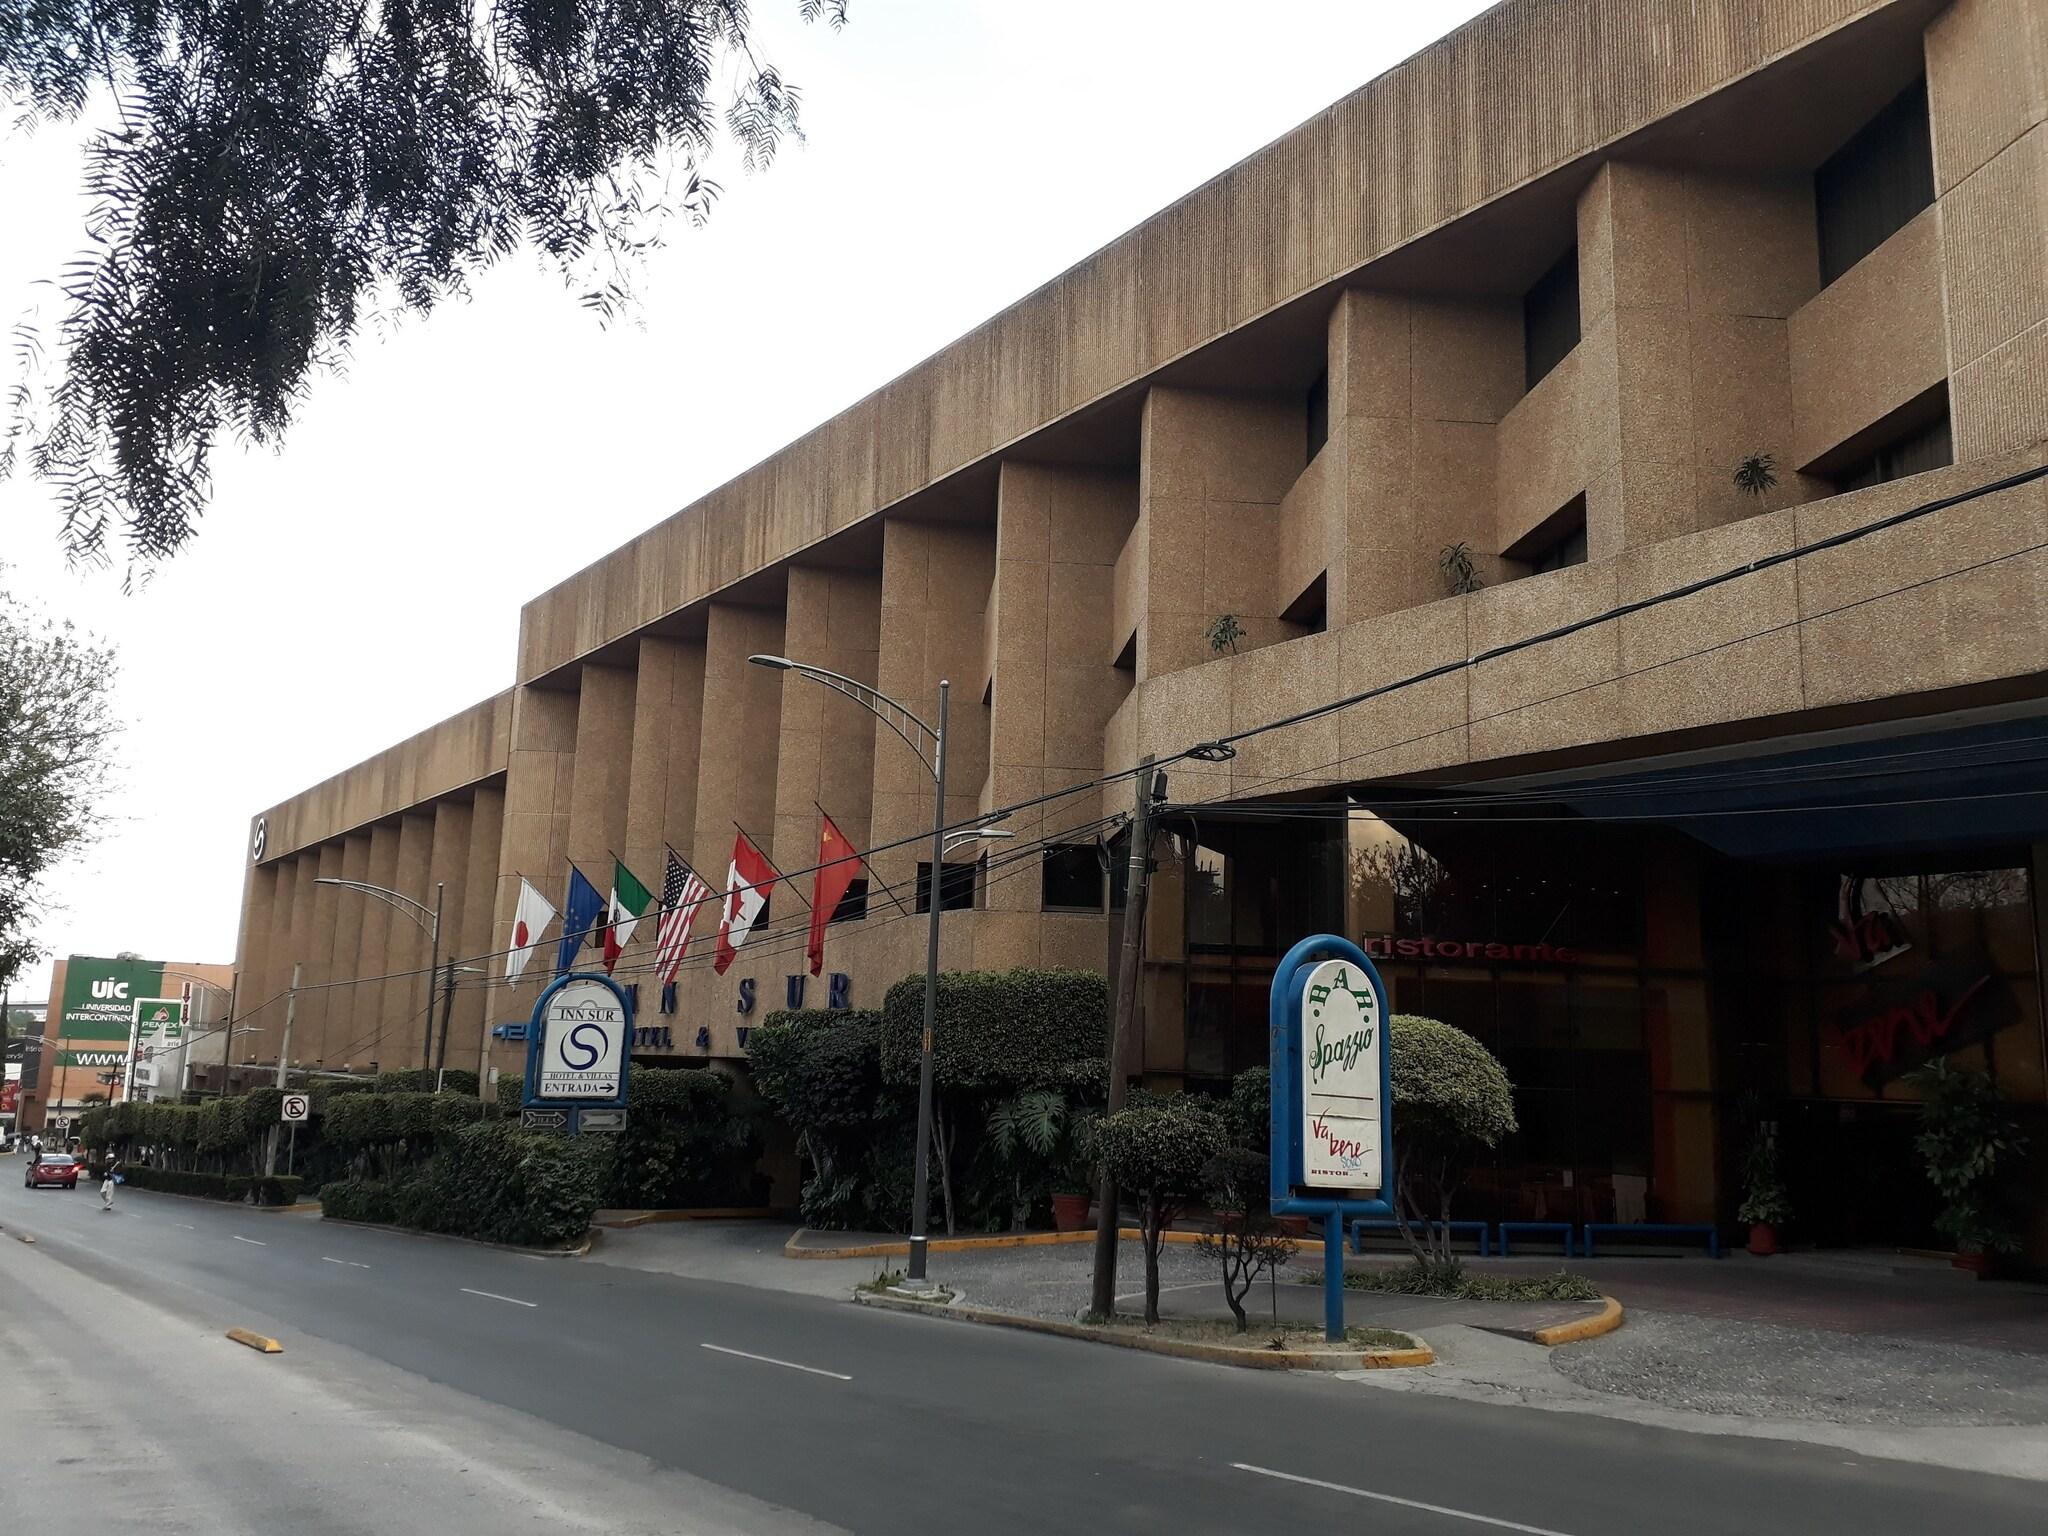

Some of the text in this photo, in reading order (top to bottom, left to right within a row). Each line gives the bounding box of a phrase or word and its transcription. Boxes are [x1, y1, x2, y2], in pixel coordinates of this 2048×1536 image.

[623, 973, 850, 1015] NN SUR
[1308, 967, 1374, 1013] BAR
[65, 1012, 135, 1023] INTERCONTINENT
[81, 1003, 132, 1012] UNIVERSIDAD
[560, 1009, 614, 1021] INN SUR
[696, 1025, 709, 1048] &
[1308, 1023, 1375, 1085] Spazzio
[544, 1083, 599, 1093] ENTRADA
[1312, 1107, 1330, 1140] Va
[1329, 1132, 1373, 1158] bene
